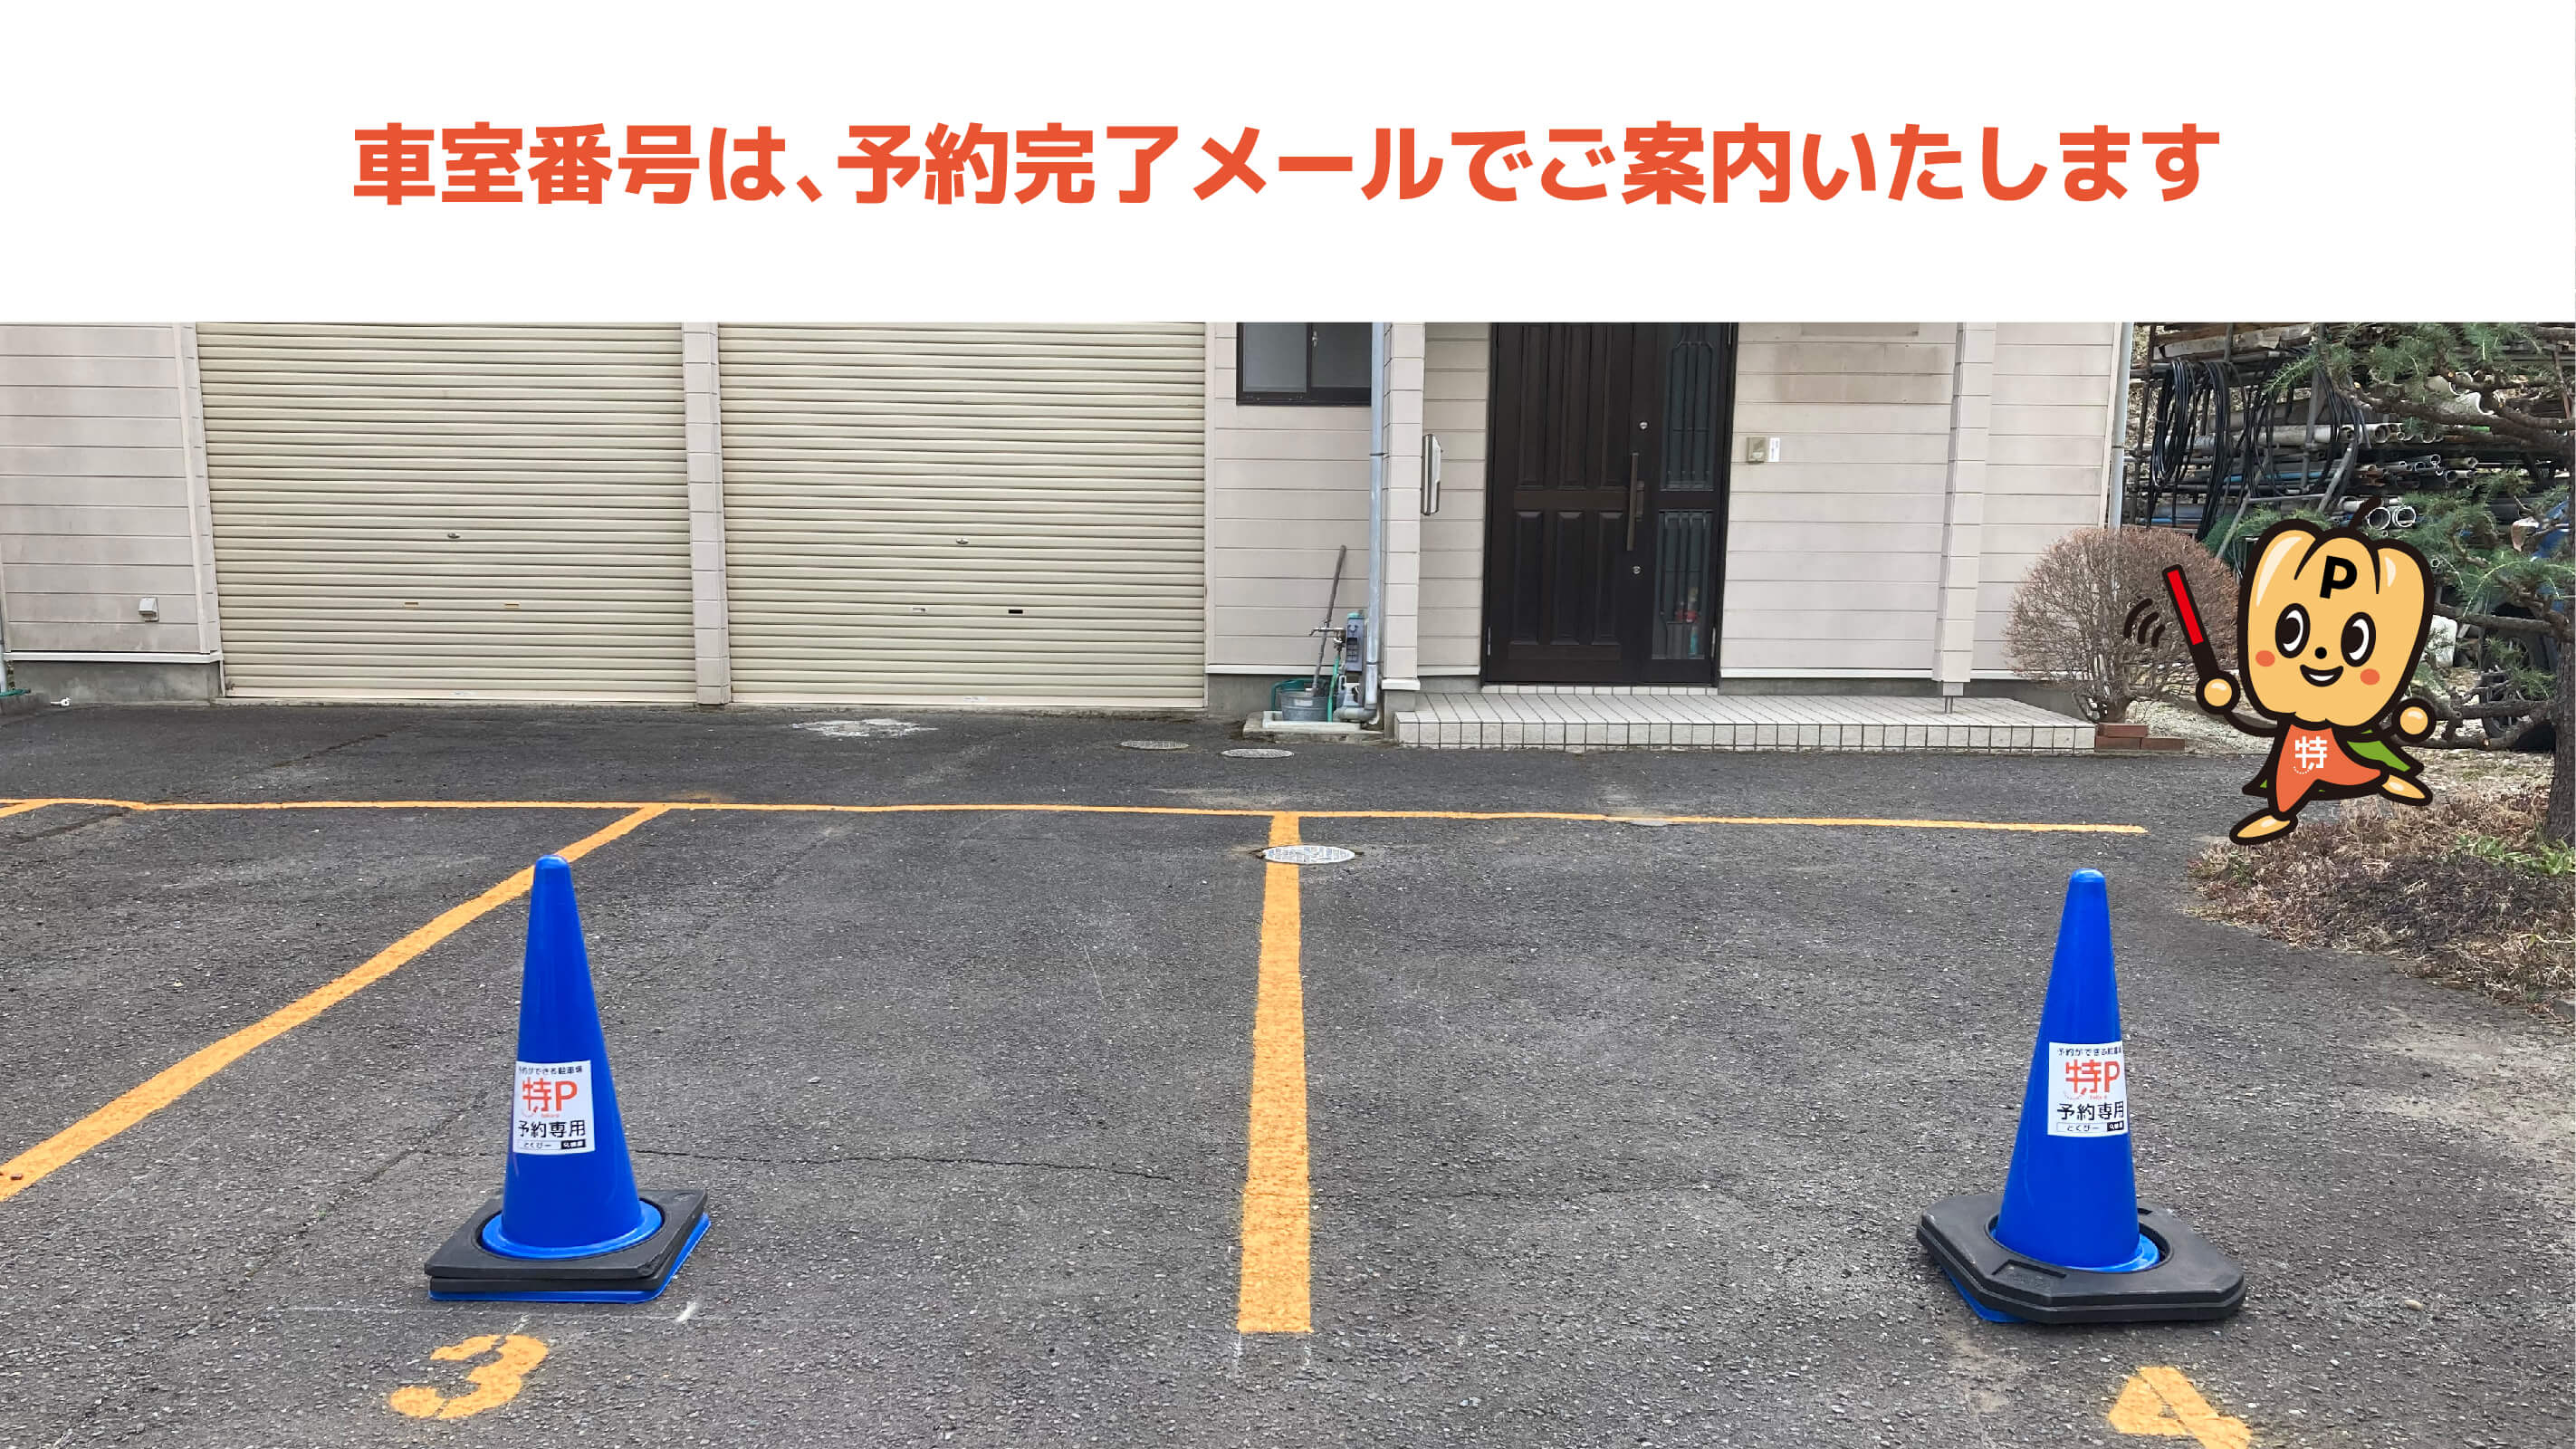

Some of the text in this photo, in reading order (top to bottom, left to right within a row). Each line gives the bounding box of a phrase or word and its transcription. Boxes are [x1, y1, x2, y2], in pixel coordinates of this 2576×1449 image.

[518, 1119, 586, 1138] 予約専用
[2057, 1101, 2124, 1121] 予約専用
[389, 1334, 549, 1419] 3
[2108, 1366, 2254, 1449] 4
